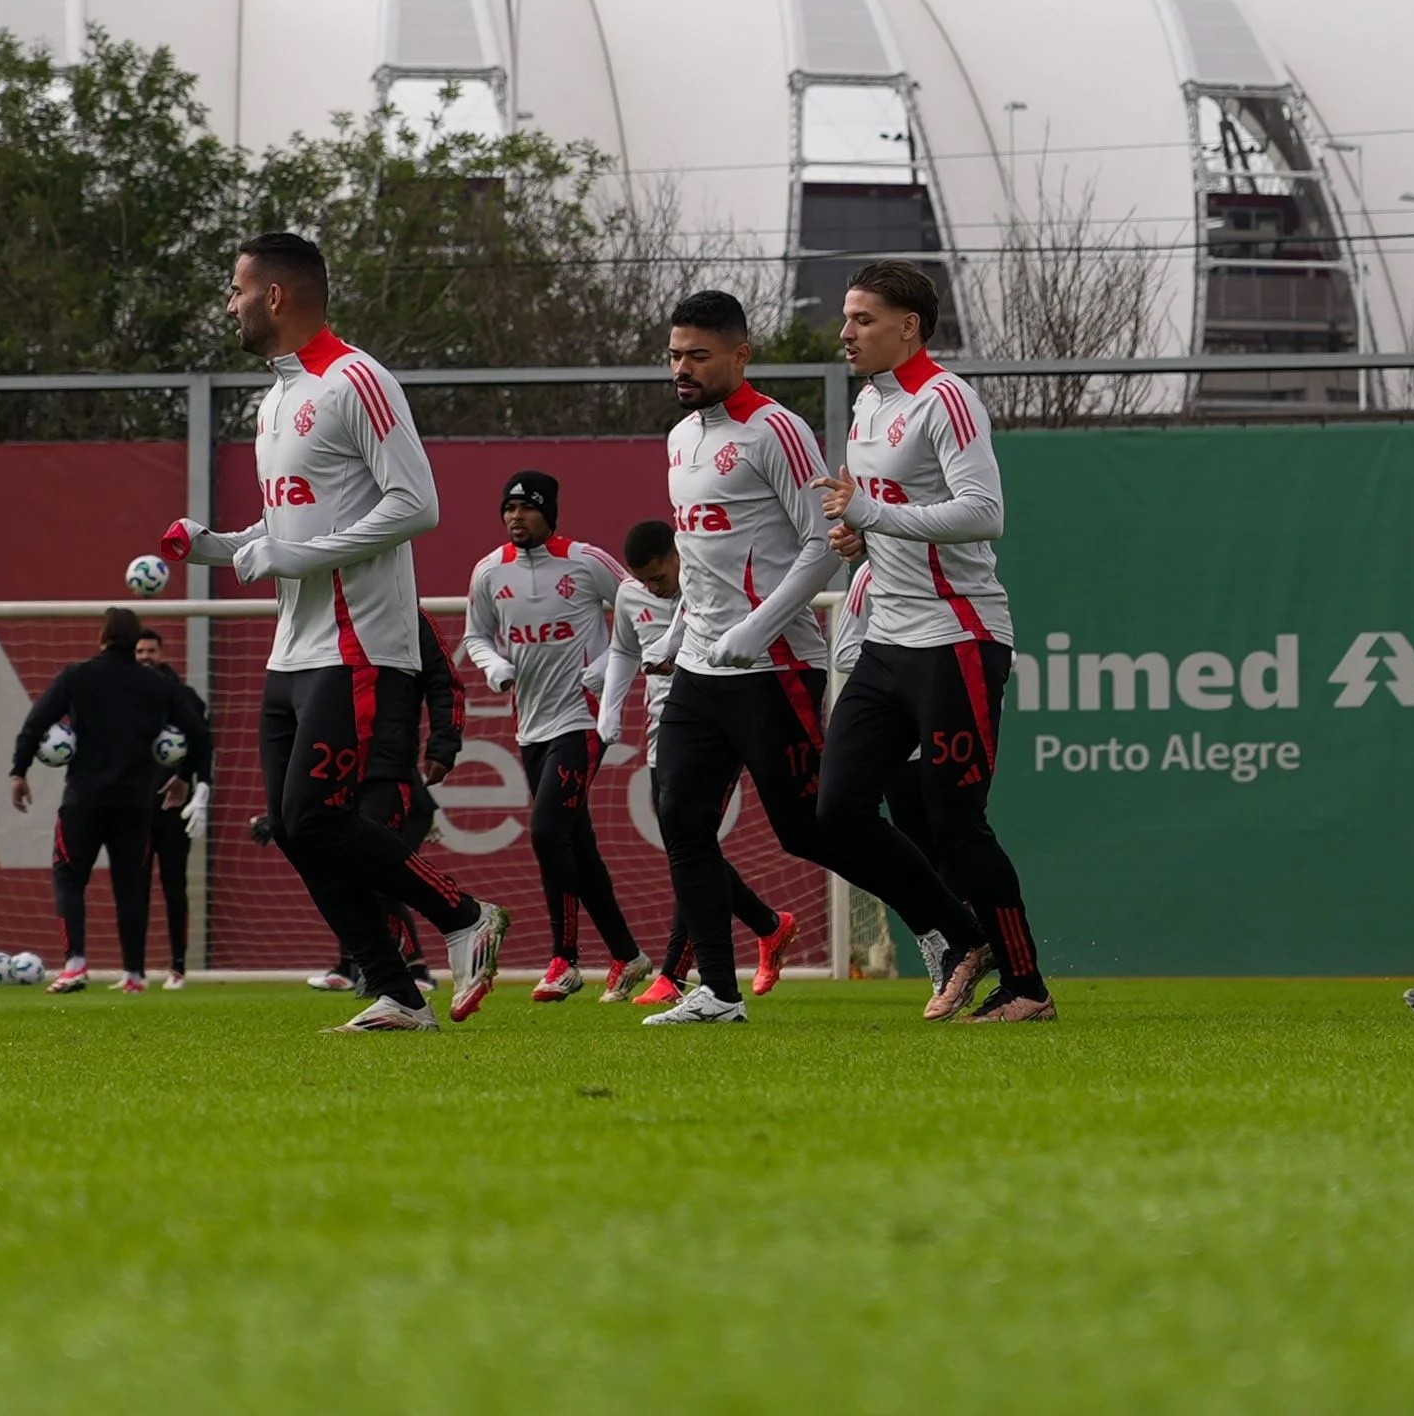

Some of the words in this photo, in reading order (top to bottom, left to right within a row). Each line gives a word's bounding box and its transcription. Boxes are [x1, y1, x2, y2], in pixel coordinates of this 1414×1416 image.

[265, 476, 317, 507] lfa
[676, 504, 732, 532] lfa
[508, 621, 575, 644] alfa
[307, 741, 355, 782] 29
[931, 730, 976, 765] 50
[1034, 734, 1151, 773] Porto
[1160, 731, 1301, 784] Alegre
